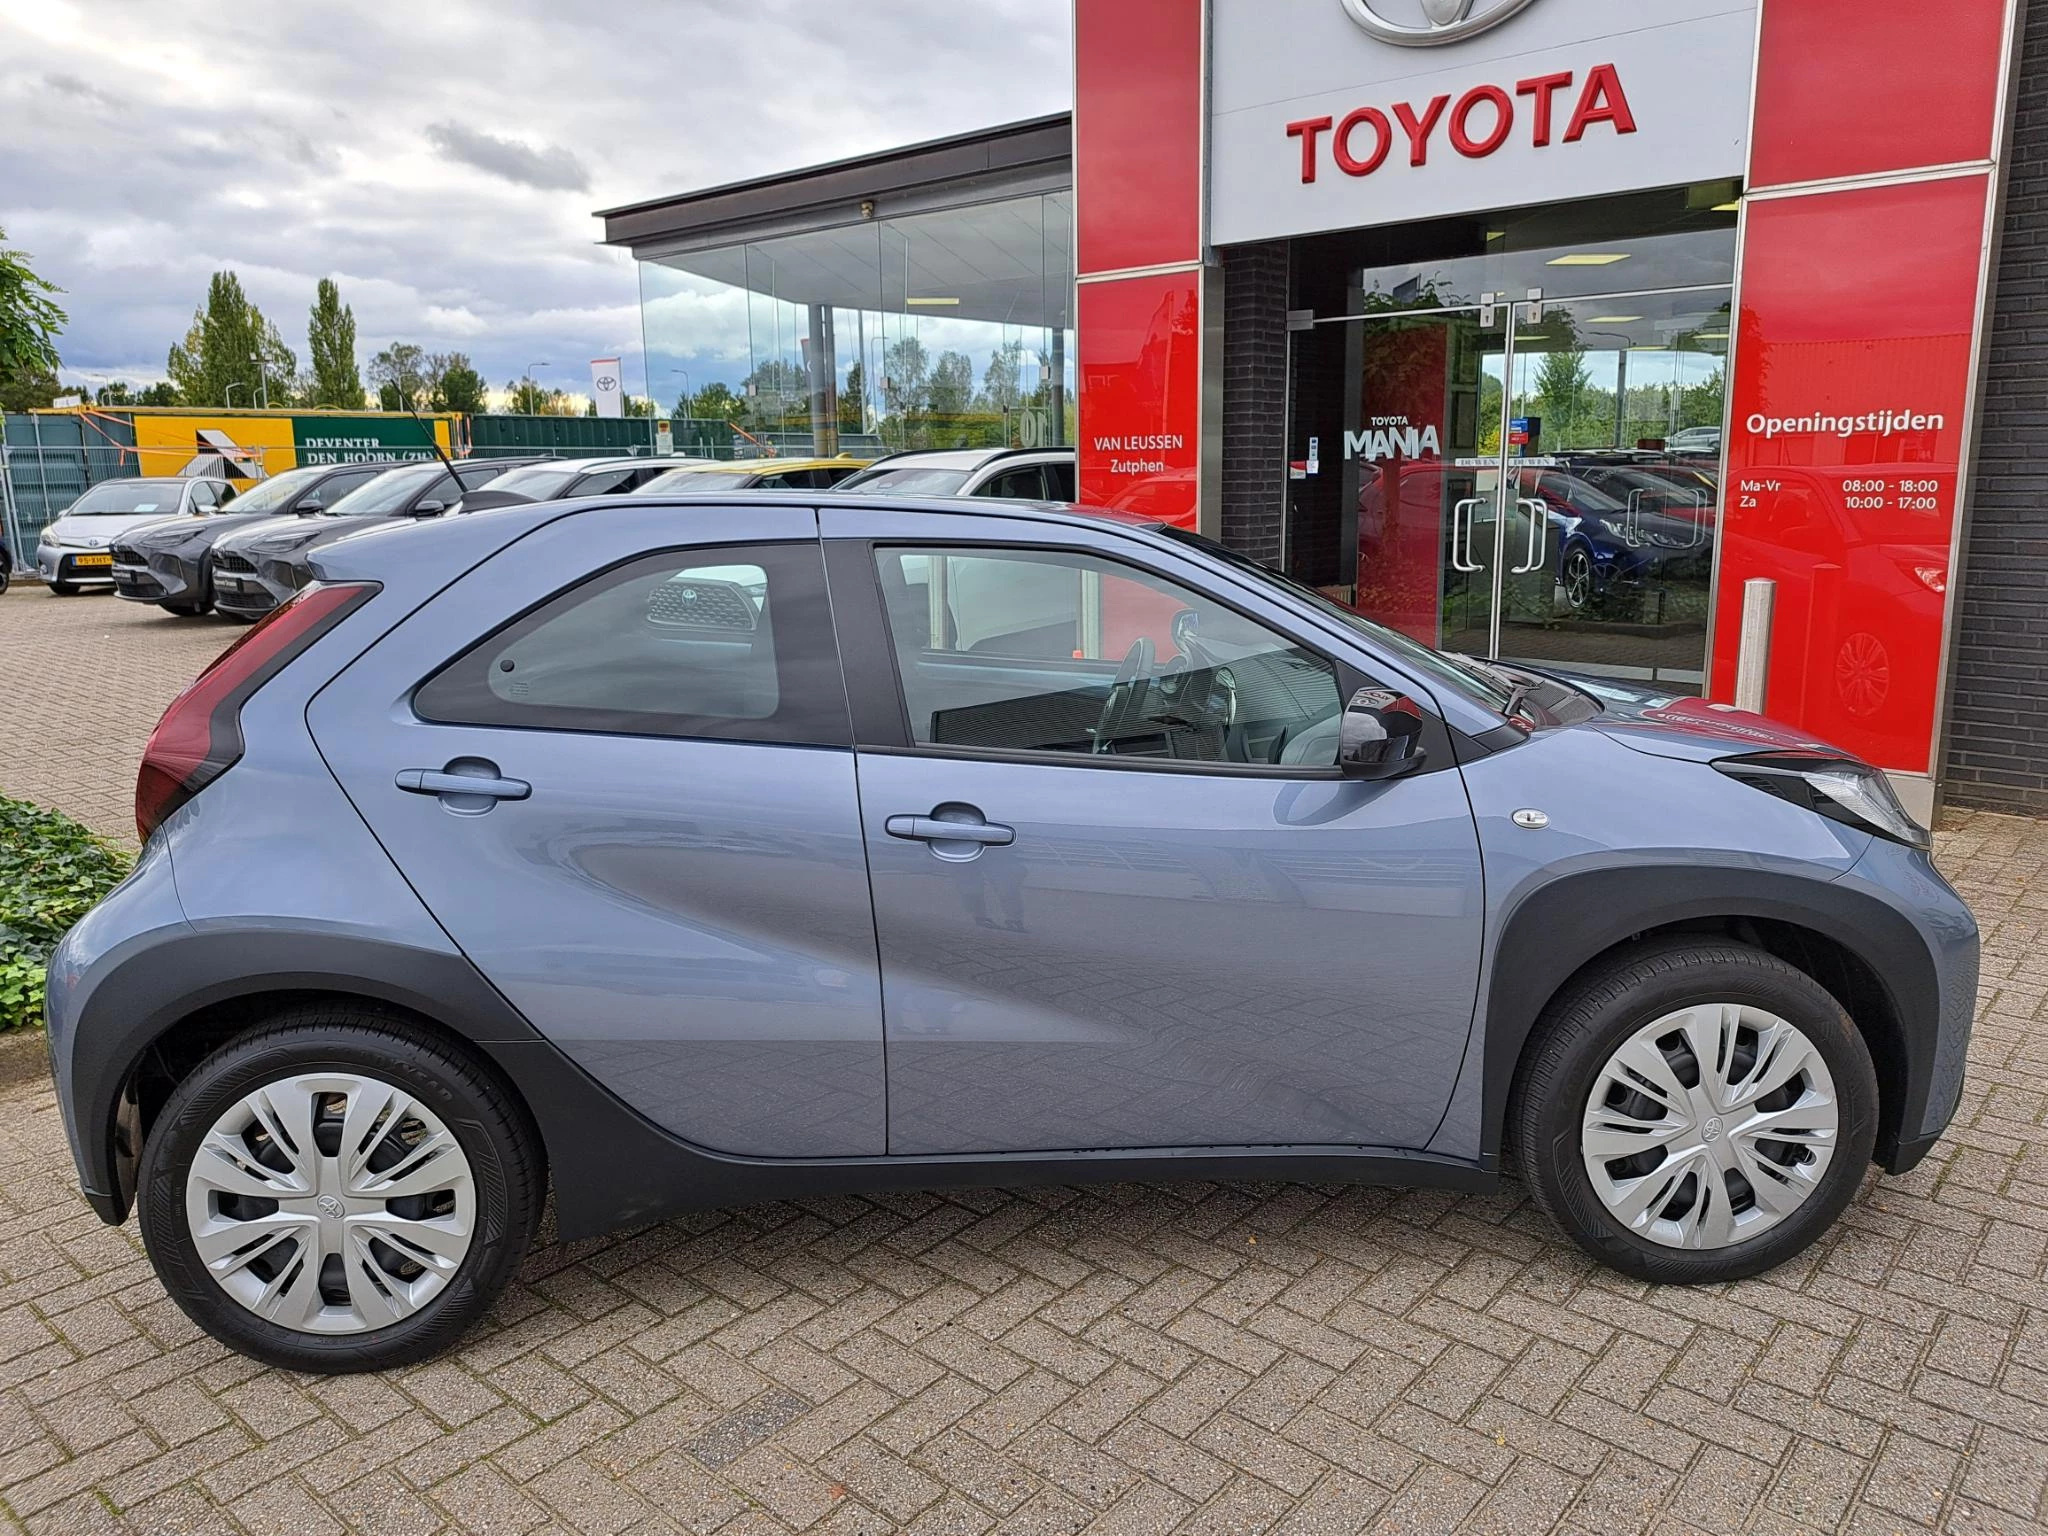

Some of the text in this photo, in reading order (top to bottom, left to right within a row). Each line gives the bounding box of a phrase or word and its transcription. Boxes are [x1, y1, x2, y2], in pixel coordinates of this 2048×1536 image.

[1286, 63, 1637, 184] TOYOTA
[1371, 416, 1408, 426] TOYOTA
[1746, 409, 1944, 439] Openingstijden
[305, 437, 380, 448] DEVENTER
[1094, 435, 1183, 451] VAN LEUSSEN
[1344, 425, 1440, 462] MANIA
[308, 452, 337, 464] DEN
[343, 451, 396, 463] HOORN
[1110, 458, 1164, 475] Zutphen
[1740, 480, 1781, 492] Ma-Vr
[1842, 480, 1885, 492] 08:00
[1899, 480, 1938, 492] 18:00
[1739, 496, 1757, 508] Za
[1846, 497, 1884, 509] 10:00
[1899, 497, 1937, 509] 17:00
